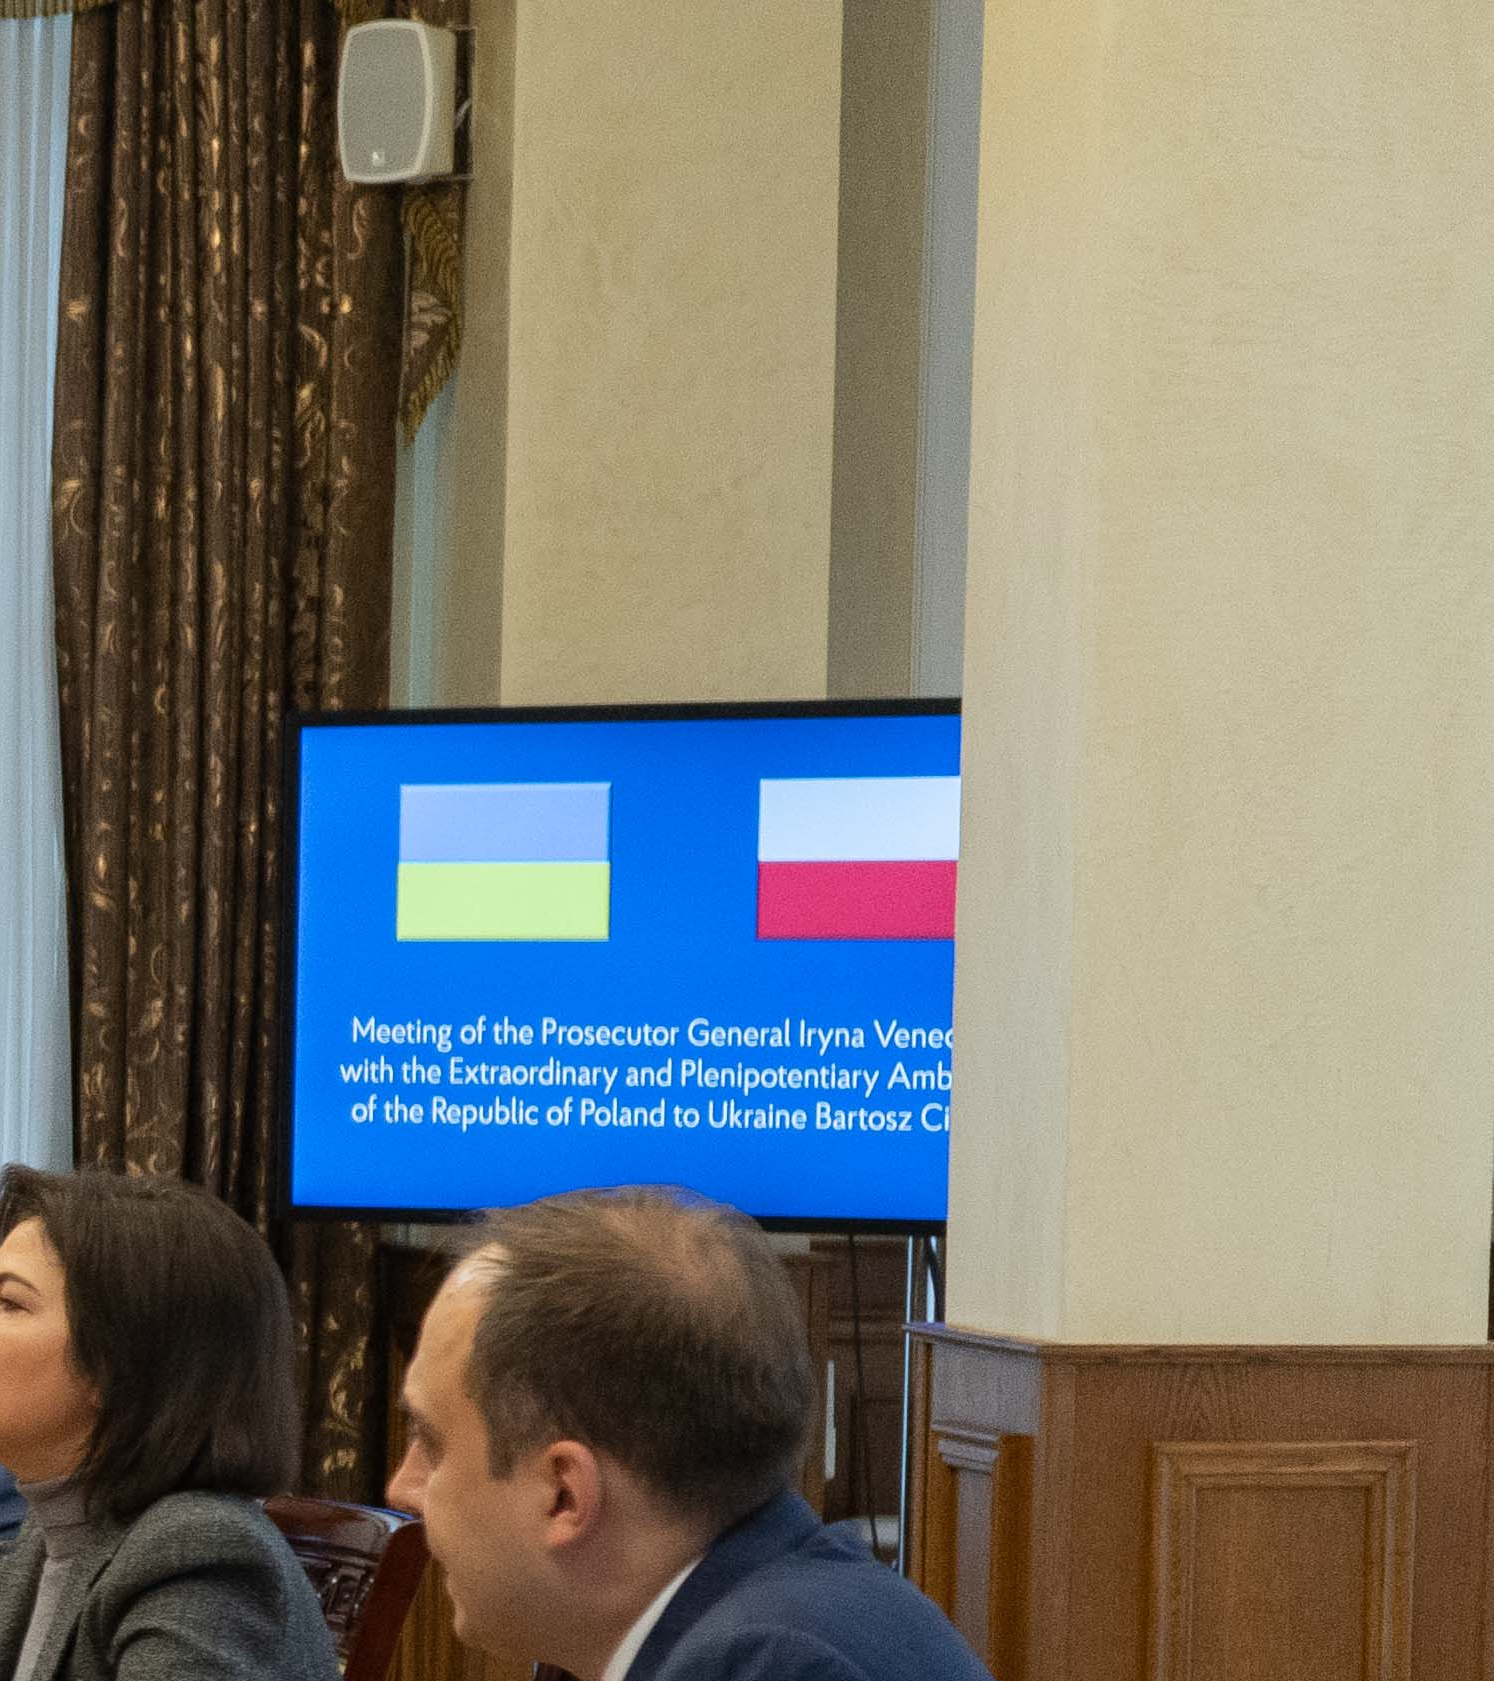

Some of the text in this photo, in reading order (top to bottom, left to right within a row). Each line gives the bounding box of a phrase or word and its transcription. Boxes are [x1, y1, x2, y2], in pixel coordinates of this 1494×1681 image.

[352, 1016, 452, 1053] Meeting
[459, 1015, 486, 1045] of
[493, 1016, 534, 1045] the
[541, 1017, 679, 1046] Prosecutor
[687, 1018, 791, 1047] General
[799, 1019, 865, 1056] Iryna
[339, 1055, 394, 1083] with
[401, 1056, 442, 1084] the
[449, 1056, 618, 1094] Extraordinary
[625, 1058, 673, 1087] and
[680, 1058, 880, 1098] Plenipotentiary
[350, 1094, 377, 1123] of
[383, 1095, 424, 1124] the
[431, 1096, 539, 1132] Republic
[545, 1096, 573, 1126] of
[580, 1098, 666, 1127] Poland
[673, 1105, 700, 1128] to
[708, 1099, 807, 1130] Ukraine
[815, 1101, 912, 1131] Bartosz
